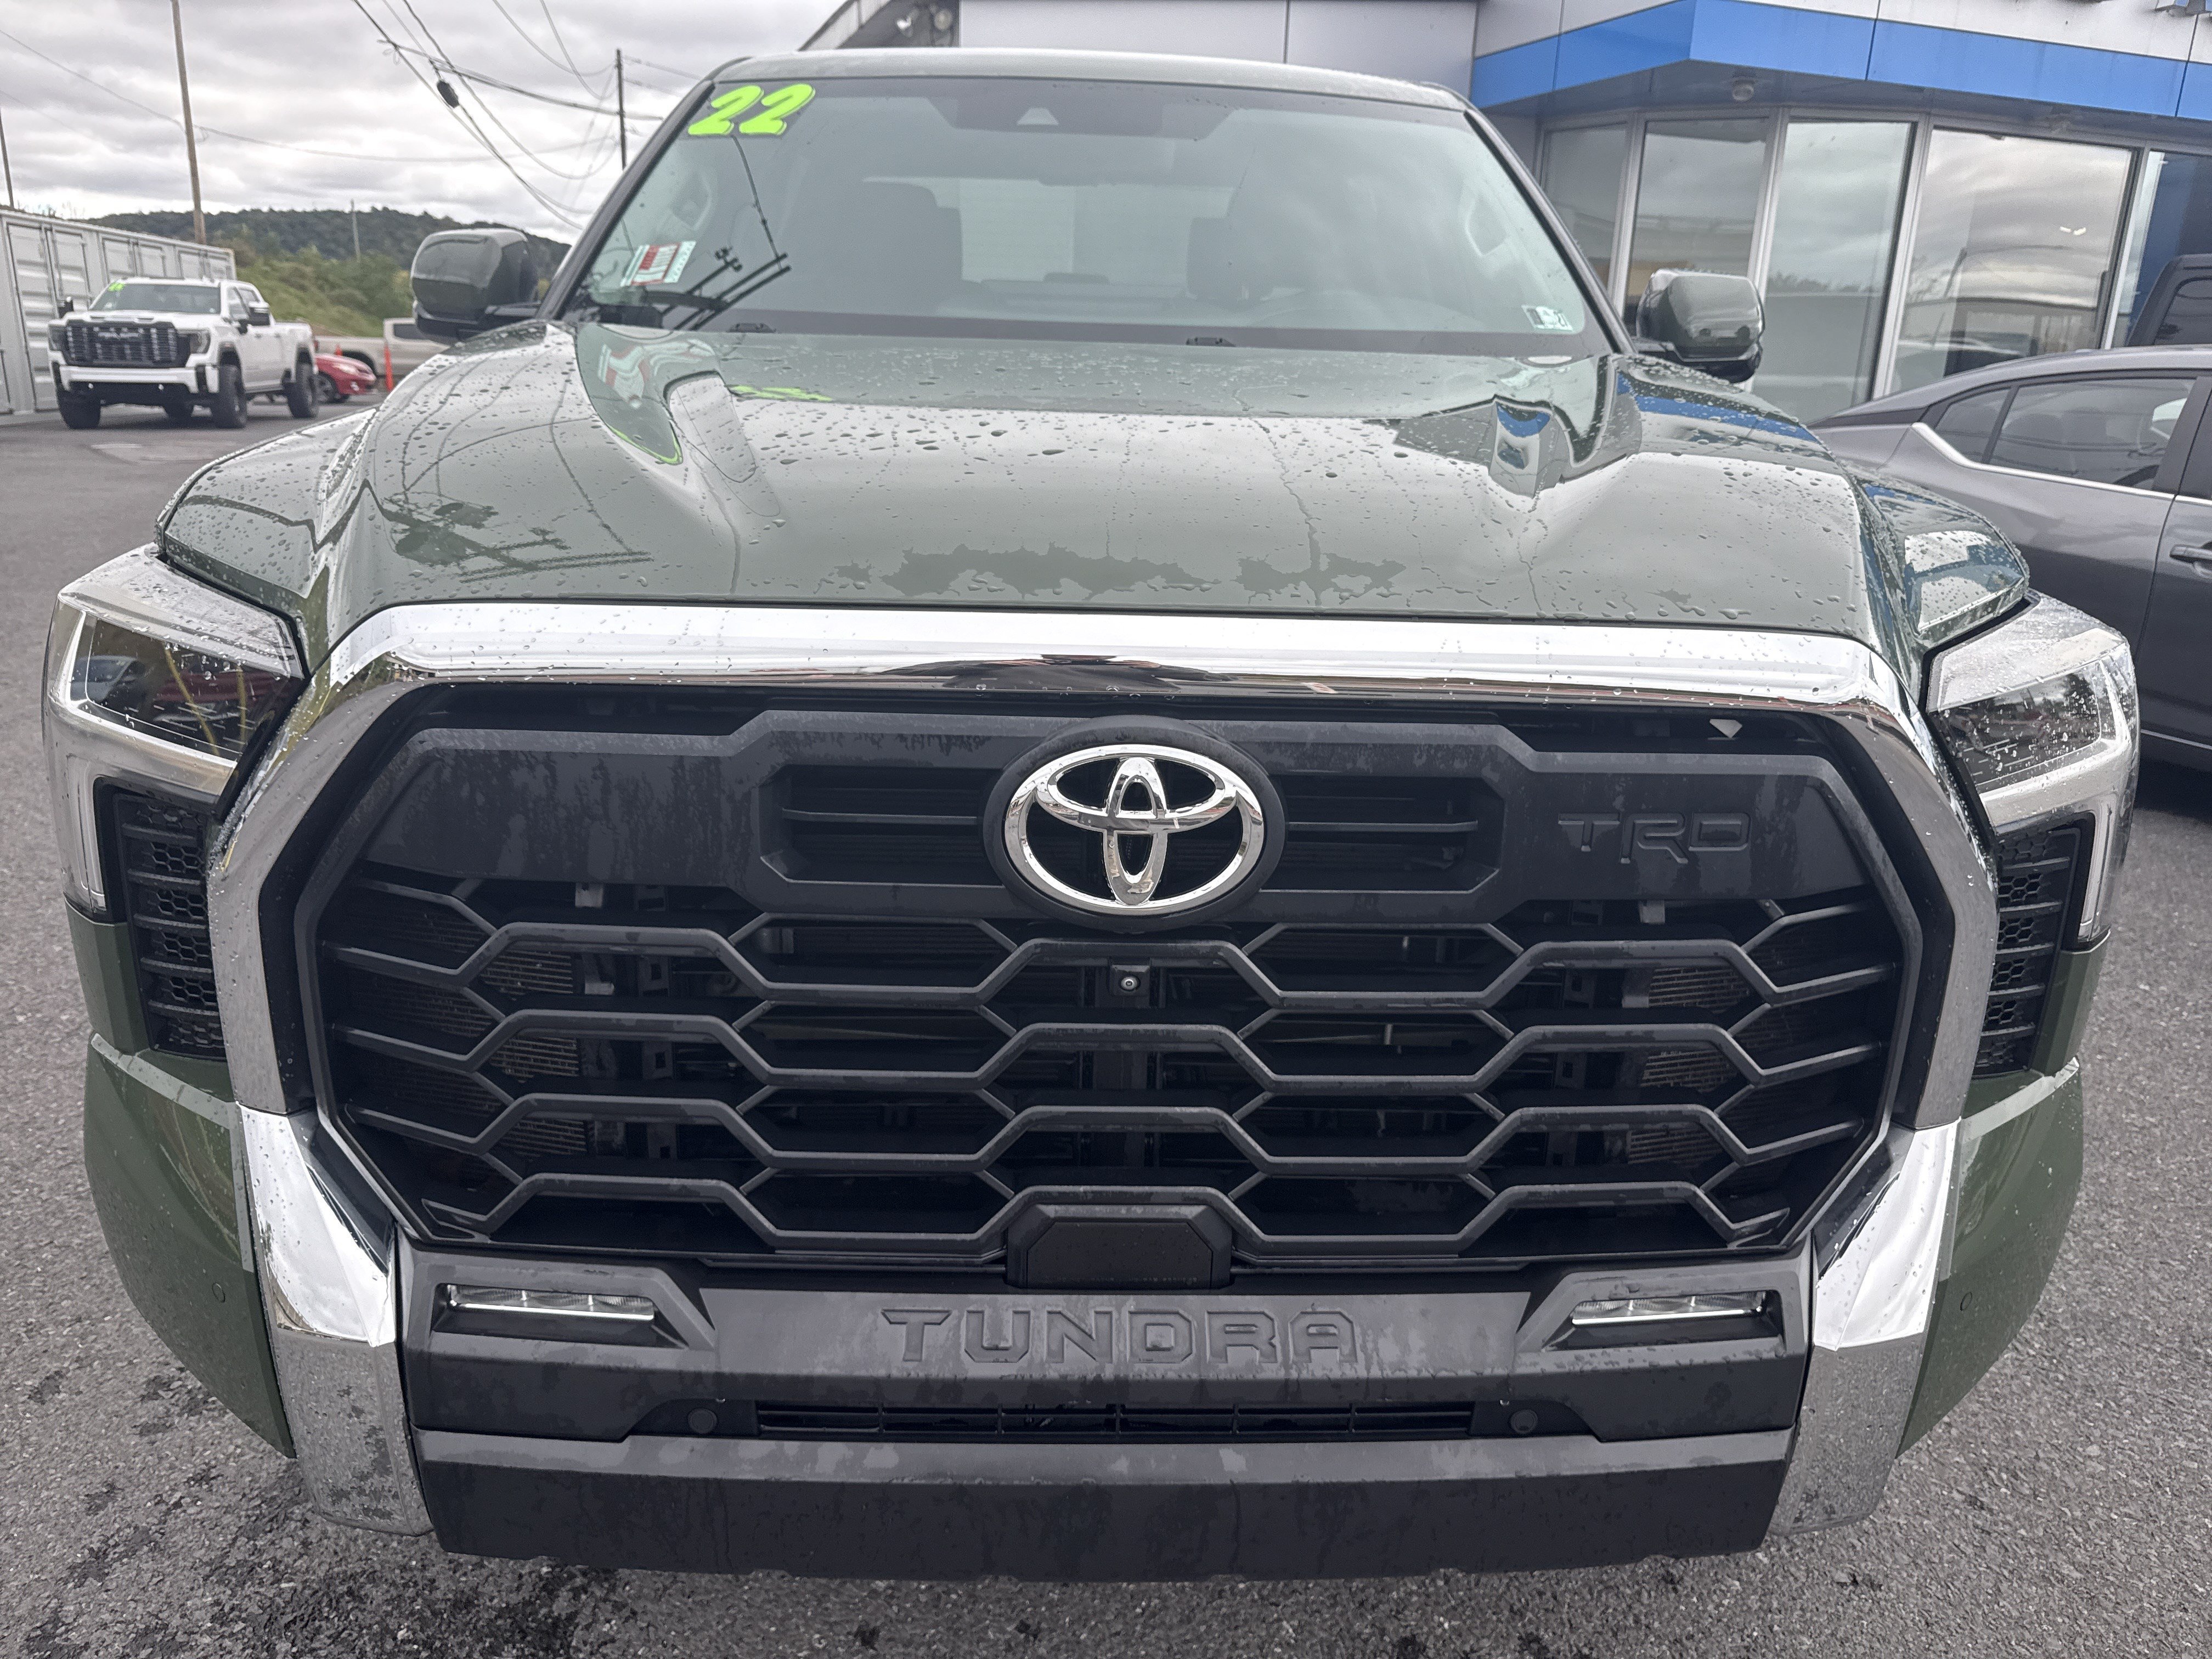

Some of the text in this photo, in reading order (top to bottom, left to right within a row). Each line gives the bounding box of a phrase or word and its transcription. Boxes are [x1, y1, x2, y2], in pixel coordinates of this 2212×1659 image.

[688, 83, 816, 136] 22
[1558, 812, 1750, 864] TRD
[881, 1309, 1358, 1364] TUNDRA
